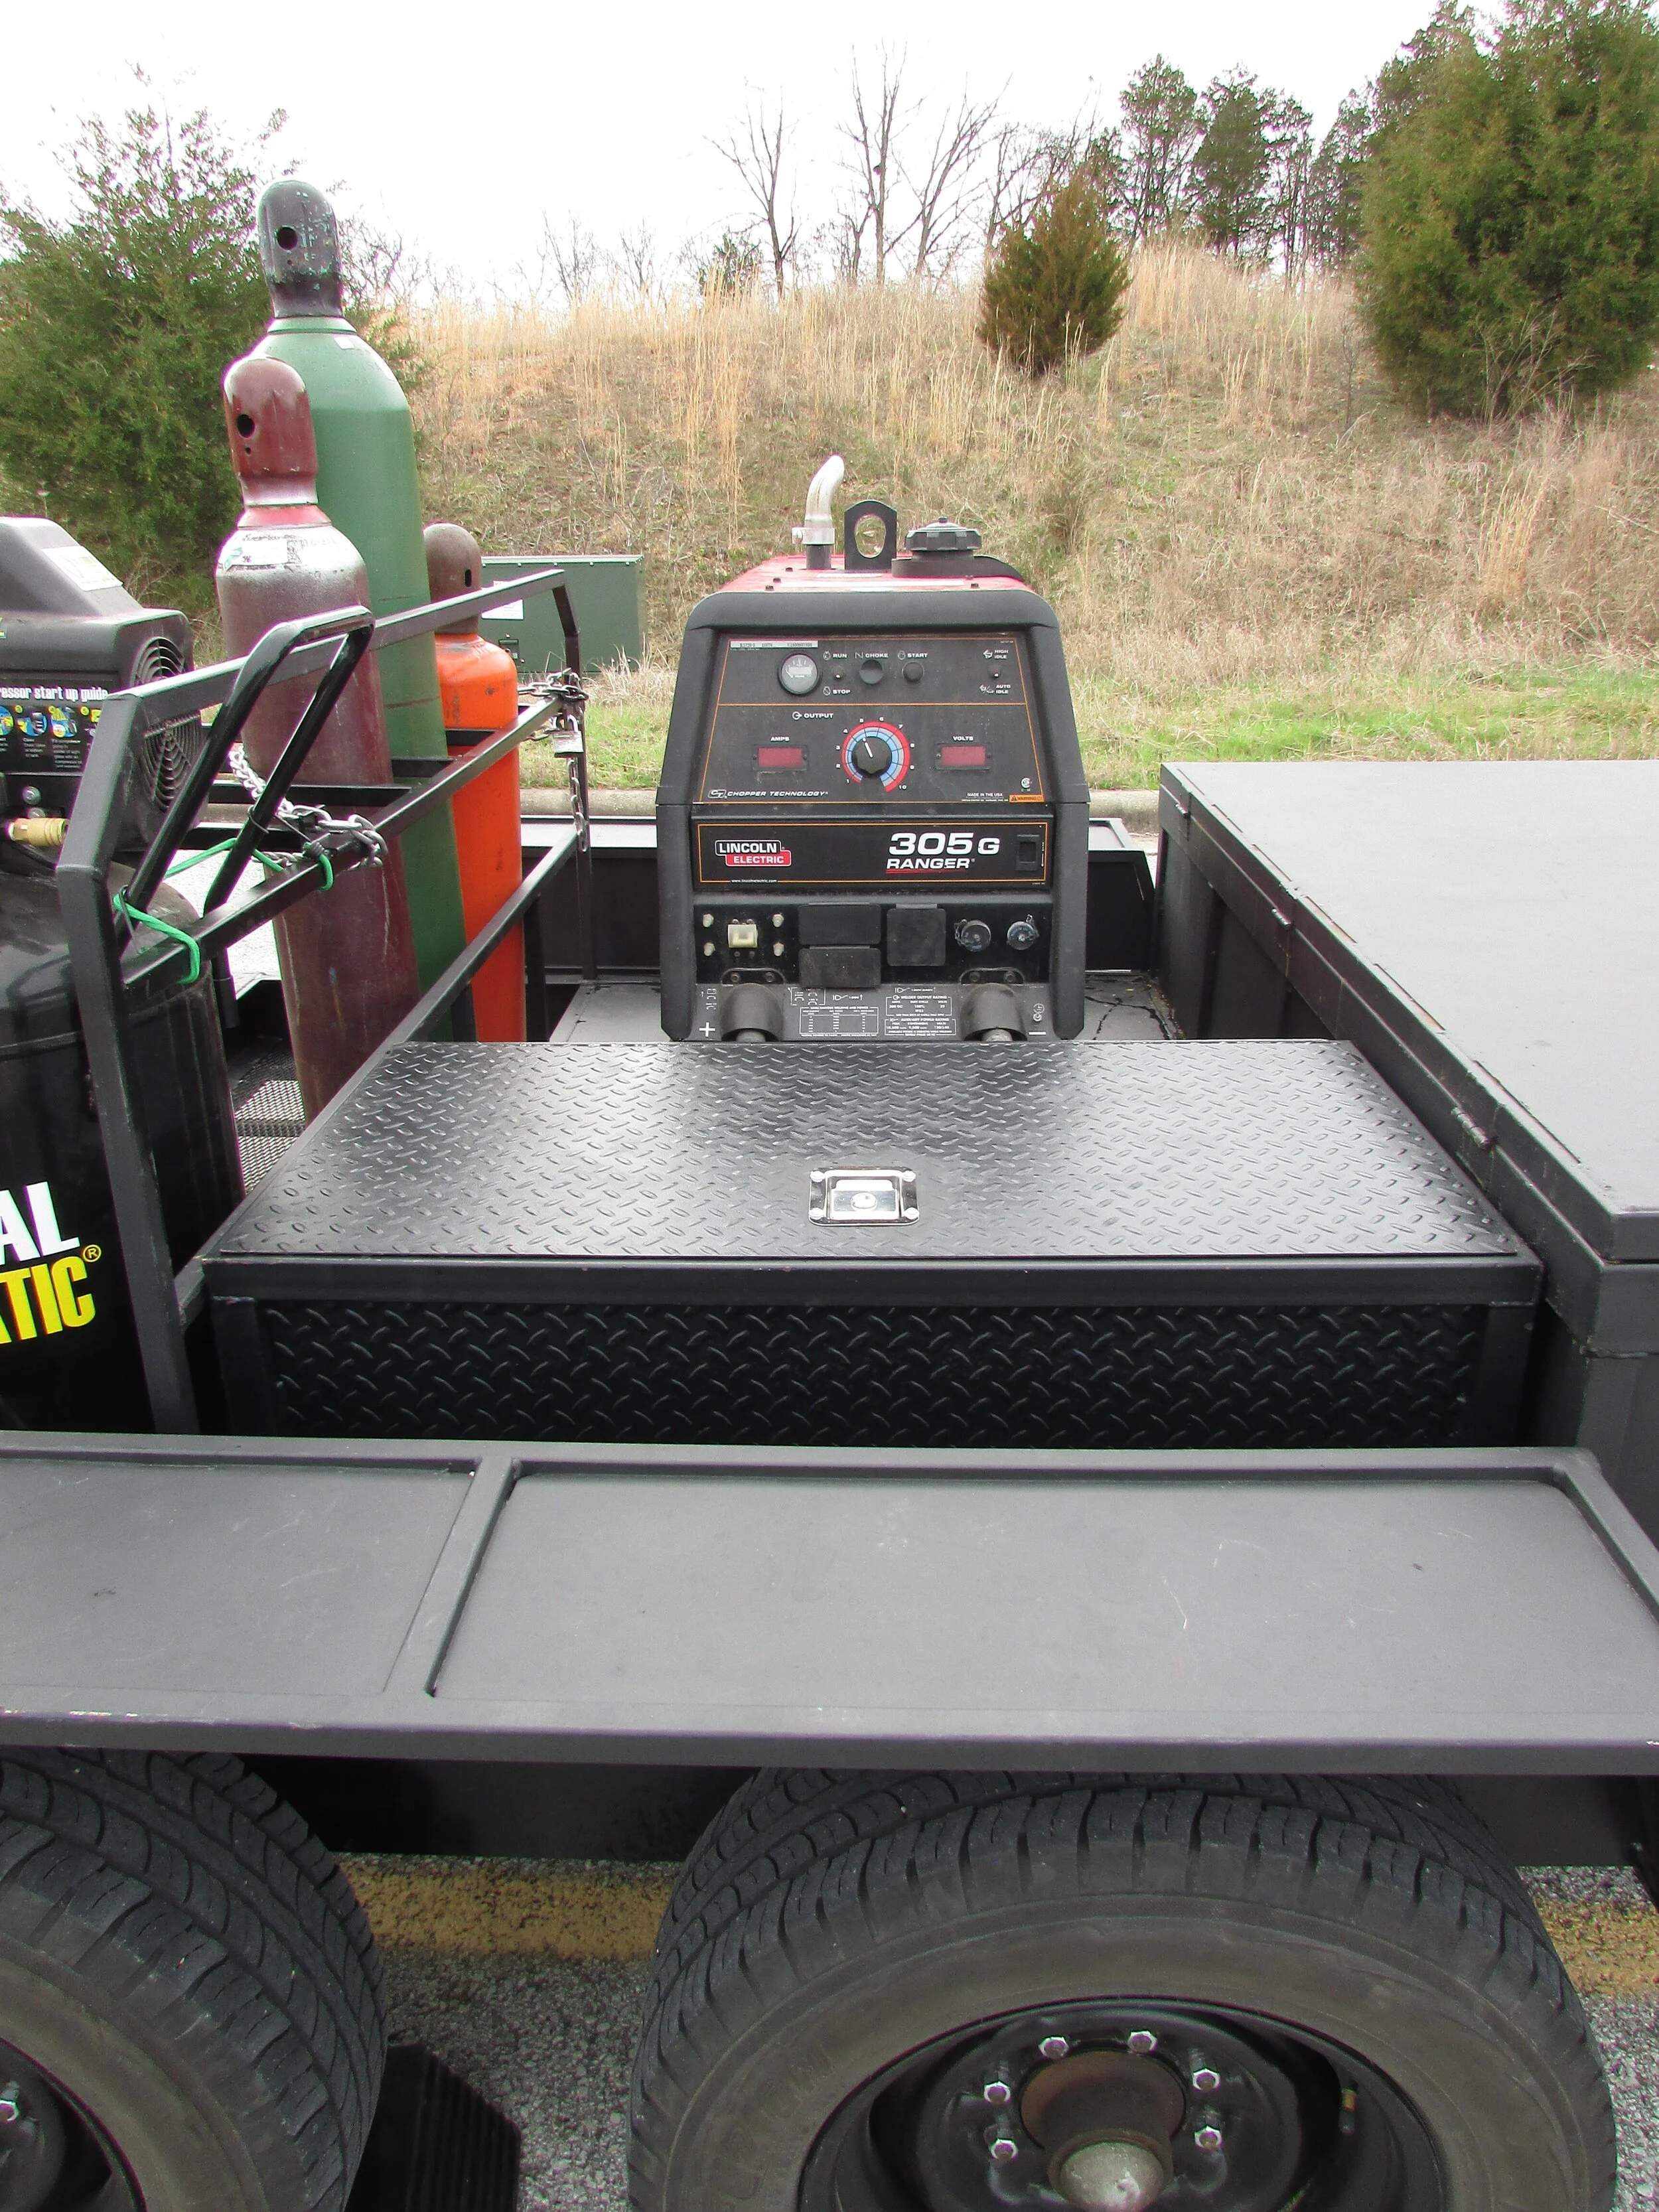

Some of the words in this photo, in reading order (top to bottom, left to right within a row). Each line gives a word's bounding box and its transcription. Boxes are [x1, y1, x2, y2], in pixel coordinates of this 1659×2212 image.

[0, 687, 32, 700] essor
[35, 686, 64, 700] start
[66, 688, 78, 702] up
[81, 686, 108, 702] guide
[719, 844, 776, 853] LINCOLN
[889, 832, 974, 855] 305
[977, 838, 1000, 854] G
[887, 858, 970, 869] RANGER
